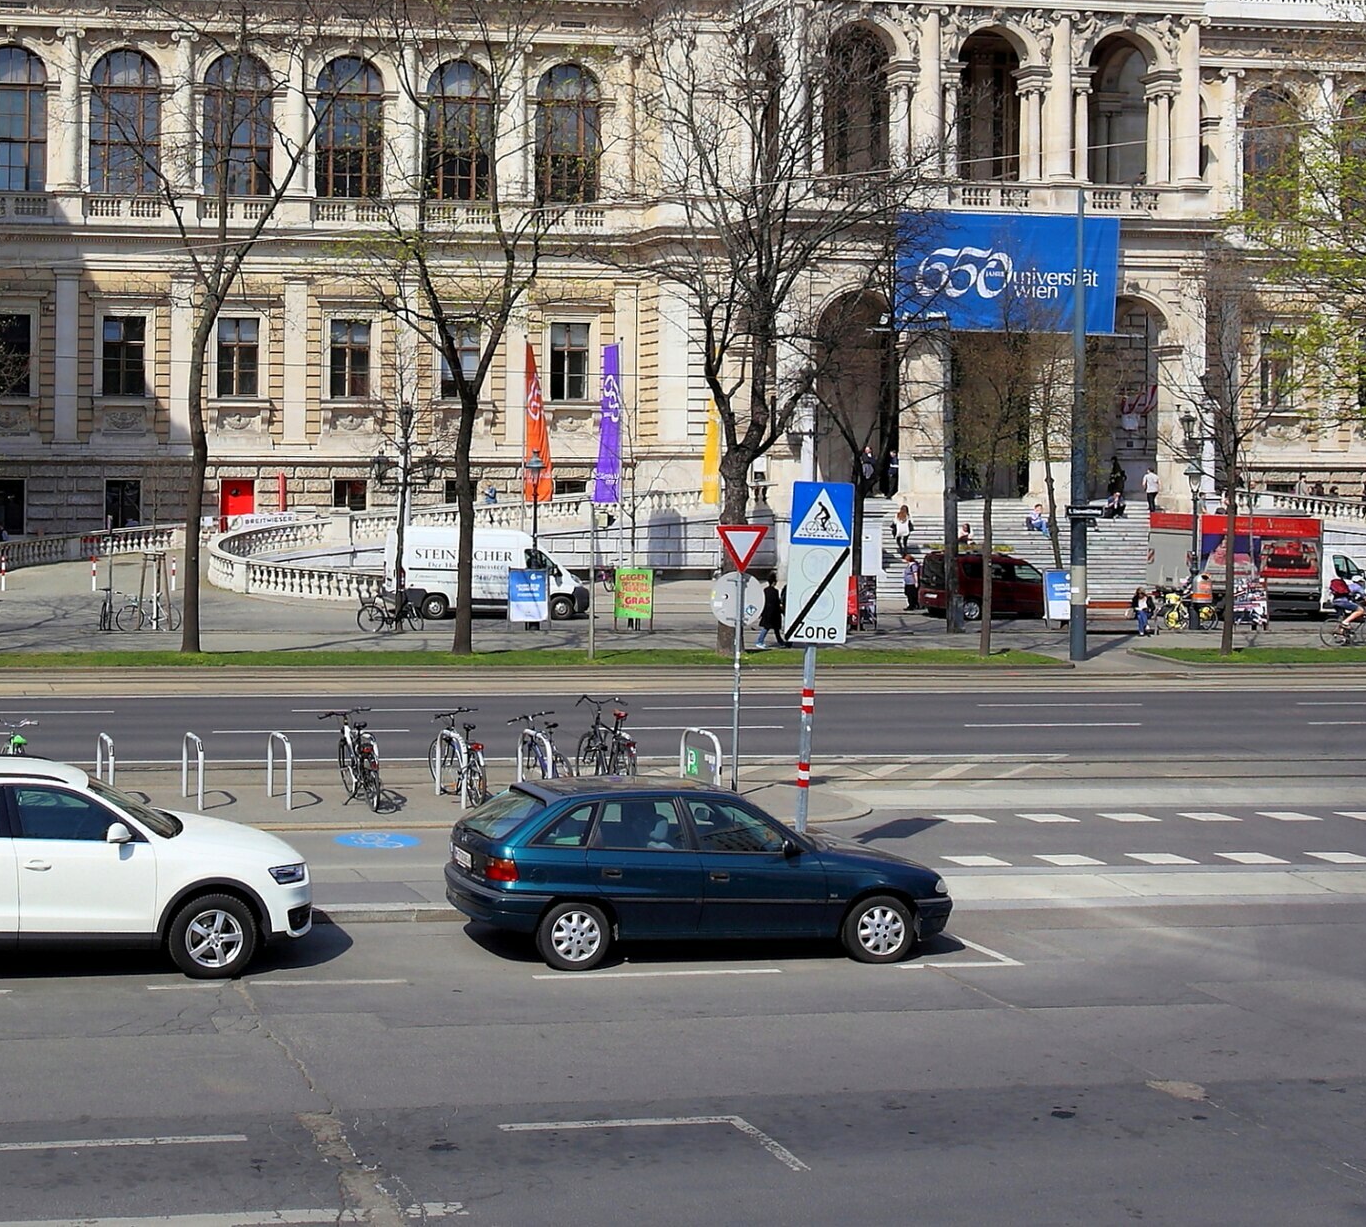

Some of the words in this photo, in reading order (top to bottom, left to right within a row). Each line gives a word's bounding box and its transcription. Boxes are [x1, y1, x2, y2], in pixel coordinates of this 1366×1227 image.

[1013, 267, 1098, 288] universiät
[1014, 283, 1059, 299] wien
[794, 622, 837, 640] Zone
